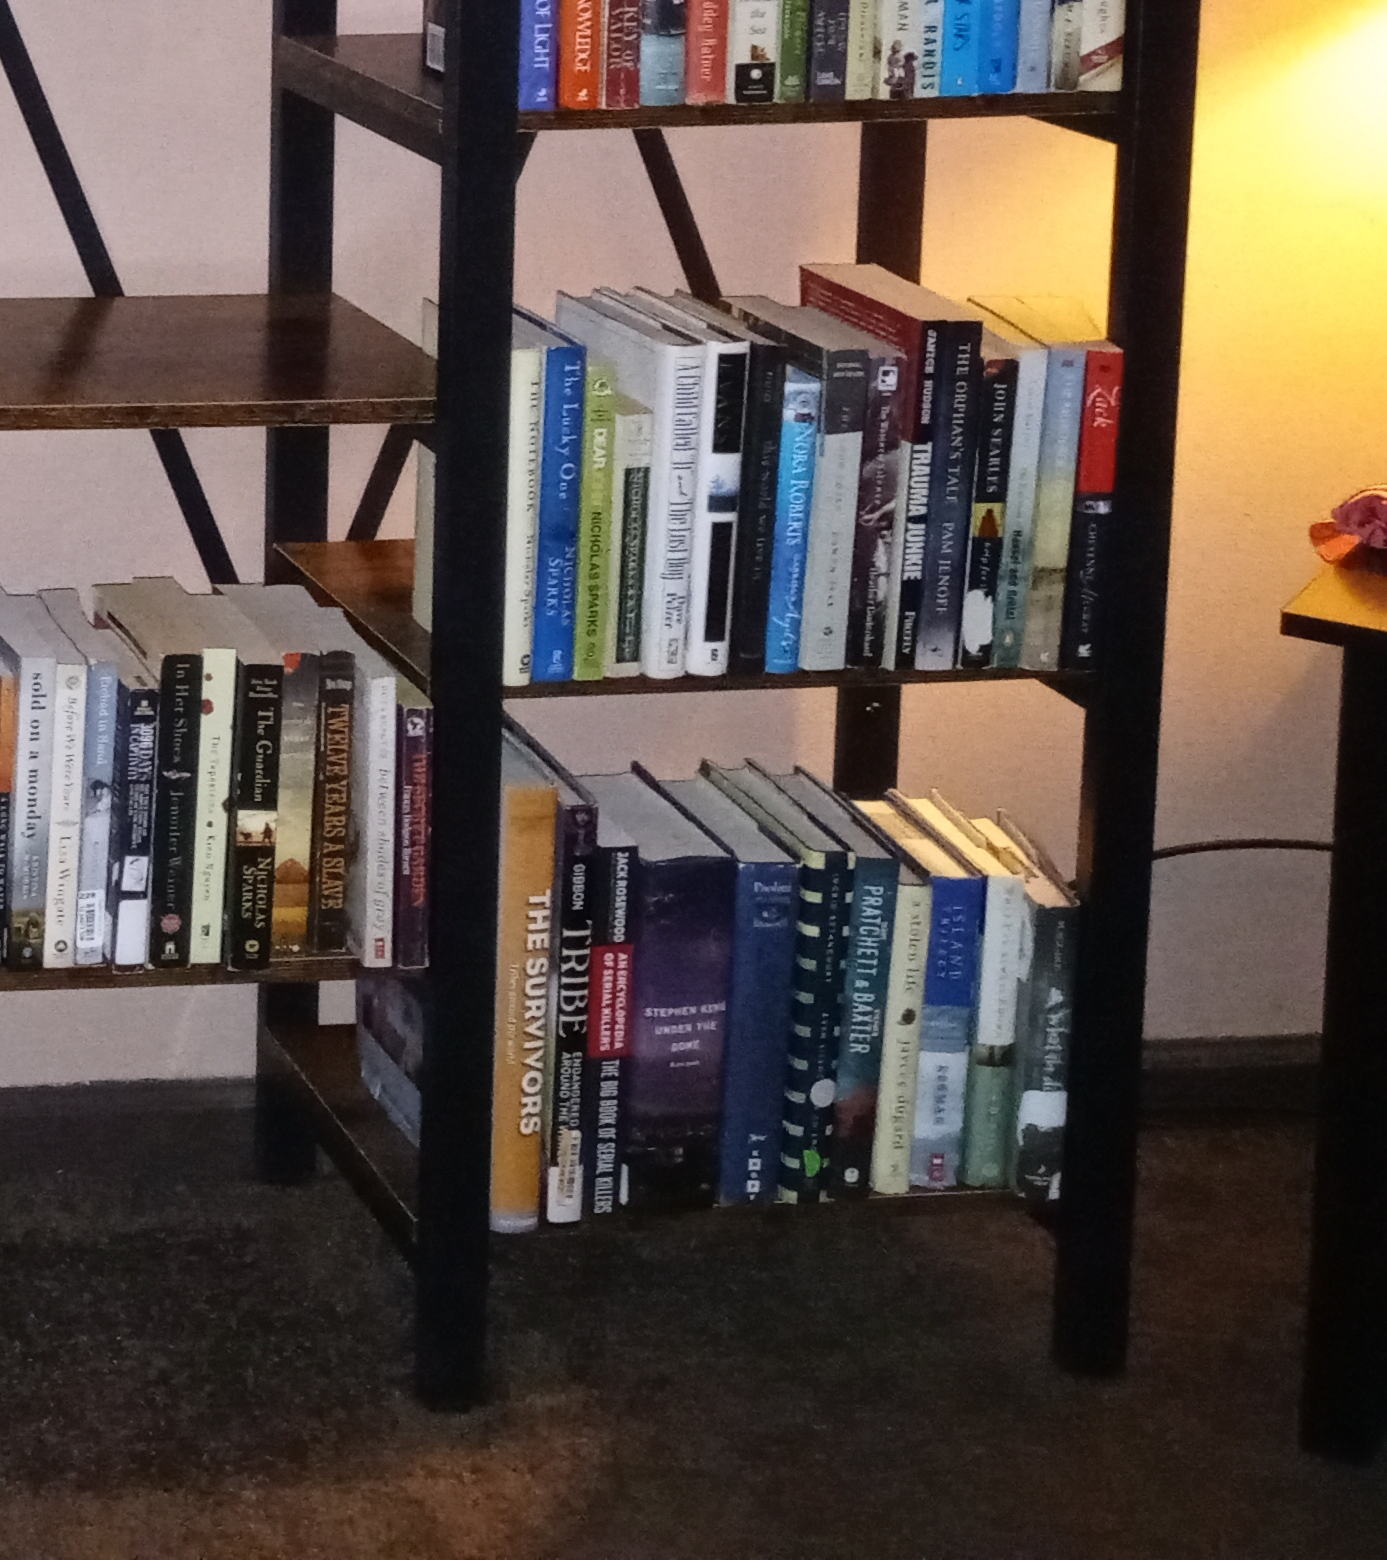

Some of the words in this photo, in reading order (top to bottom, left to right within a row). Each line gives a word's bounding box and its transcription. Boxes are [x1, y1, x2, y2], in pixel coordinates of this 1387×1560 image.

[533, 23, 553, 70] LIGHT
[564, 361, 582, 396] The
[956, 342, 971, 376] THE
[950, 381, 969, 460] ORPHAN'S
[993, 382, 1007, 423] JOHN
[554, 403, 580, 459] Lucky
[593, 427, 607, 469] DEAR
[792, 424, 814, 478] NORA
[558, 462, 576, 500] One
[908, 442, 933, 517] TRAUMA
[945, 462, 962, 504] TALE
[986, 428, 1003, 494] SEARLES
[786, 479, 810, 546] ROBERTS
[587, 511, 602, 582] NICHOLAS
[902, 520, 926, 581] JUNKIE
[941, 521, 955, 555] PAM
[545, 556, 563, 617] SPARKS
[561, 545, 575, 627] NICHOLAS
[936, 560, 951, 614] JENOFF
[585, 584, 600, 638] SPARKS
[30, 671, 48, 711] sold
[28, 720, 41, 741] on
[257, 709, 275, 736] The
[28, 751, 40, 760] a
[254, 741, 273, 802] Guardian
[20, 768, 42, 840] monday
[571, 863, 586, 911] GIBBON
[616, 852, 629, 878] JACK
[241, 865, 257, 920] SPARKS
[255, 858, 272, 929] NICHOLAS
[614, 880, 628, 943] ROSEWOOD
[527, 889, 552, 951] THE
[558, 920, 593, 1038] TRIBE
[603, 952, 615, 967] OF
[601, 970, 614, 1007] SERIAL
[519, 957, 550, 1135] SURVIVORS
[599, 1009, 613, 1051] KILLERS
[600, 1059, 620, 1078] THE
[600, 1081, 619, 1097] BIG
[597, 1128, 616, 1140] OF
[598, 1099, 618, 1126] BOOK
[596, 1142, 616, 1174] SERIAL
[593, 1176, 614, 1214] KILLERS
